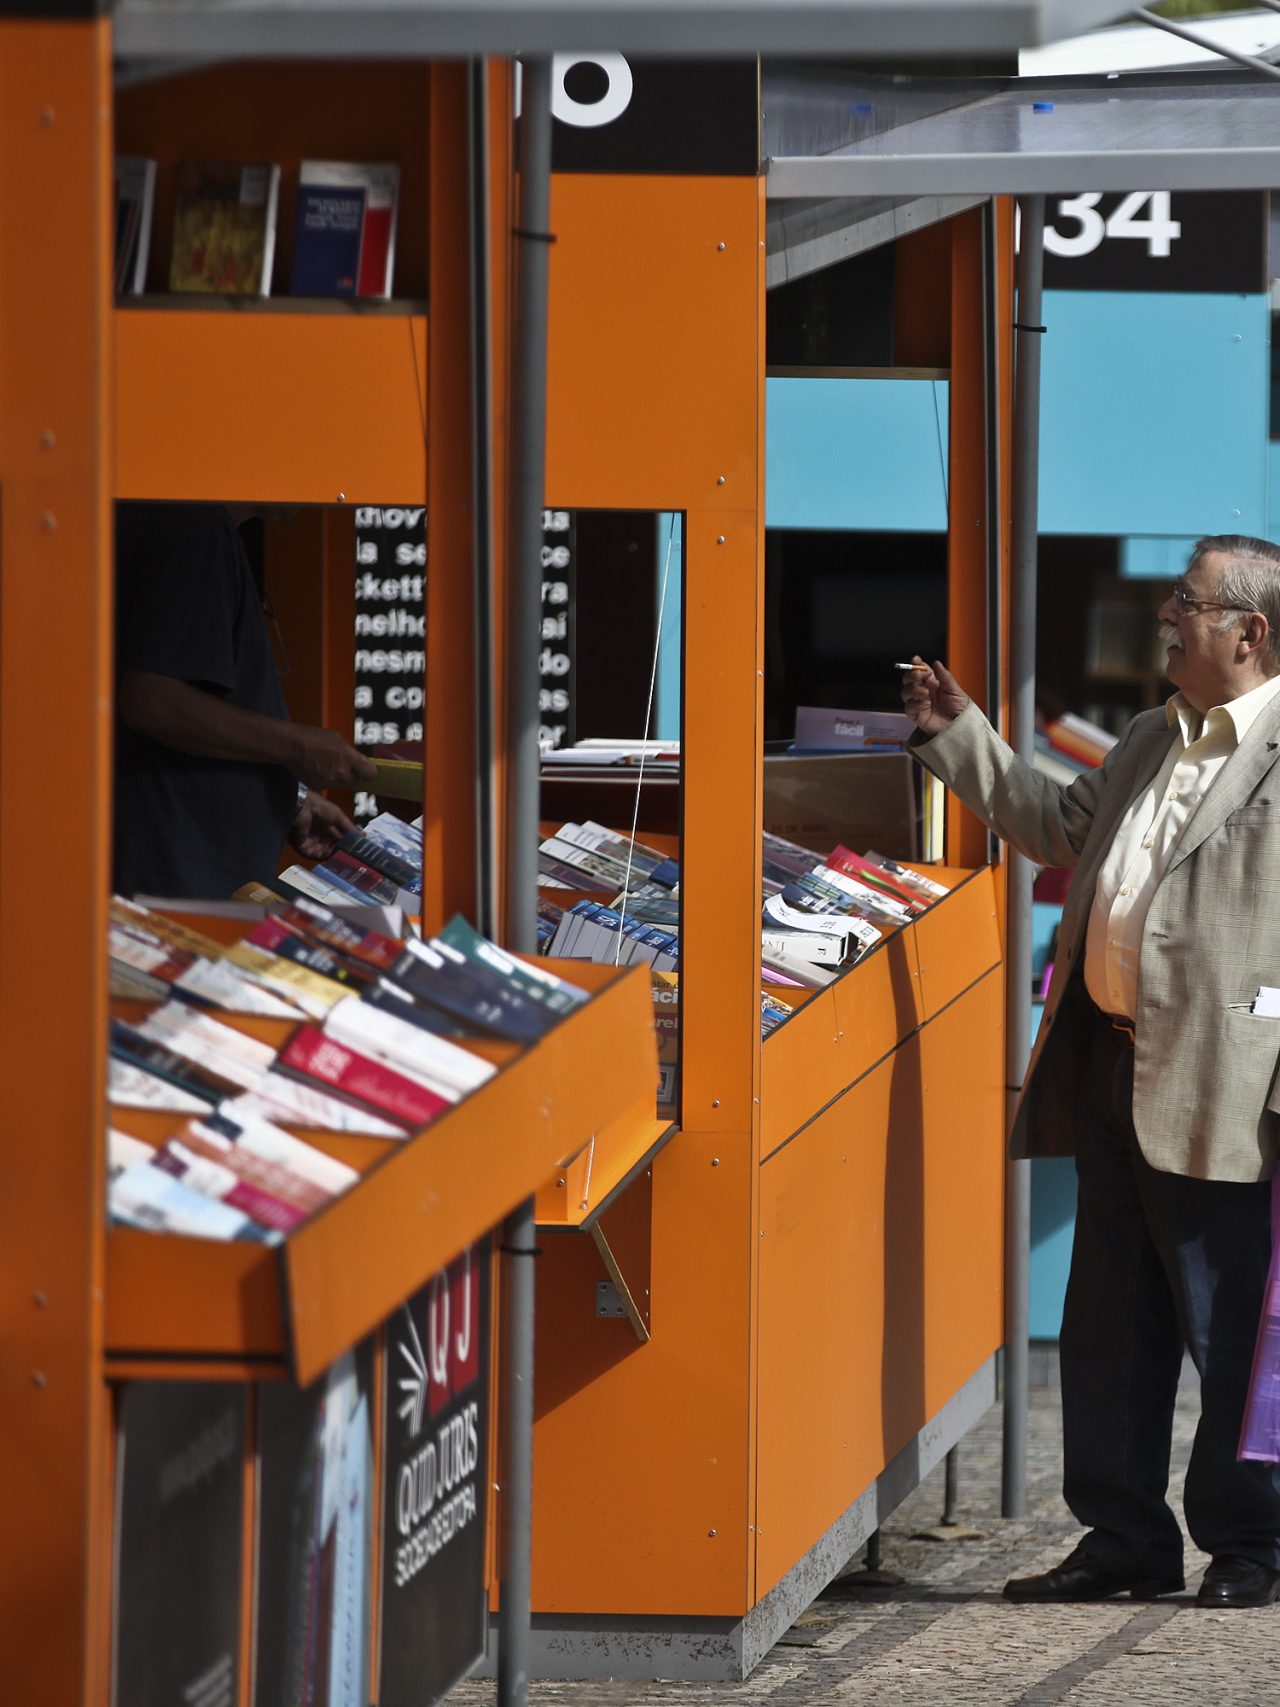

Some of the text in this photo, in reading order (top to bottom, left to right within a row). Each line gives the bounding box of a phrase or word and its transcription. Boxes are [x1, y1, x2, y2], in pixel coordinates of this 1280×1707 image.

[1043, 191, 1182, 258] 34
[651, 986, 679, 1004] áci
[396, 1401, 480, 1536] QUID JURIS
